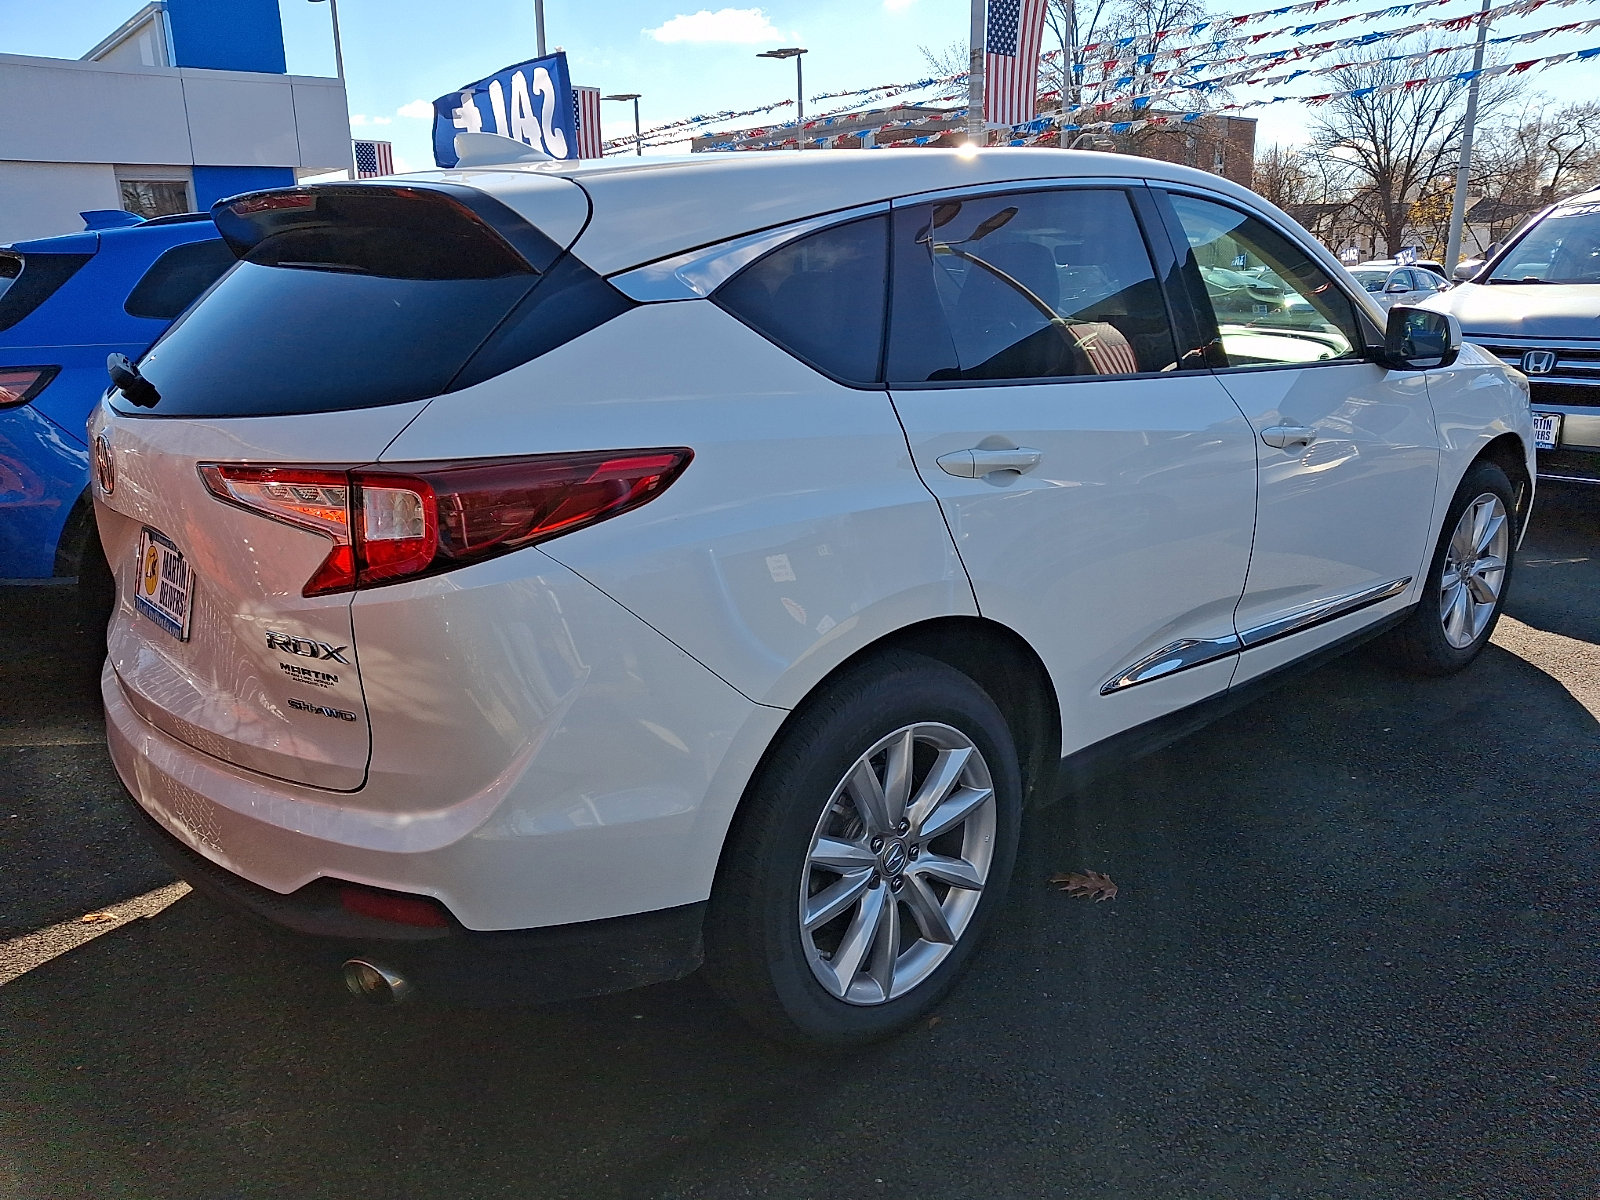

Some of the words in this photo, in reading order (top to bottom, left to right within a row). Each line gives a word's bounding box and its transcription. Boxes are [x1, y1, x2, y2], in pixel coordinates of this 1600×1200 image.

[1533, 418, 1552, 430] RTIN
[162, 550, 187, 589] MARTIN
[266, 630, 350, 665] RDX
[280, 662, 339, 683] MARTIN
